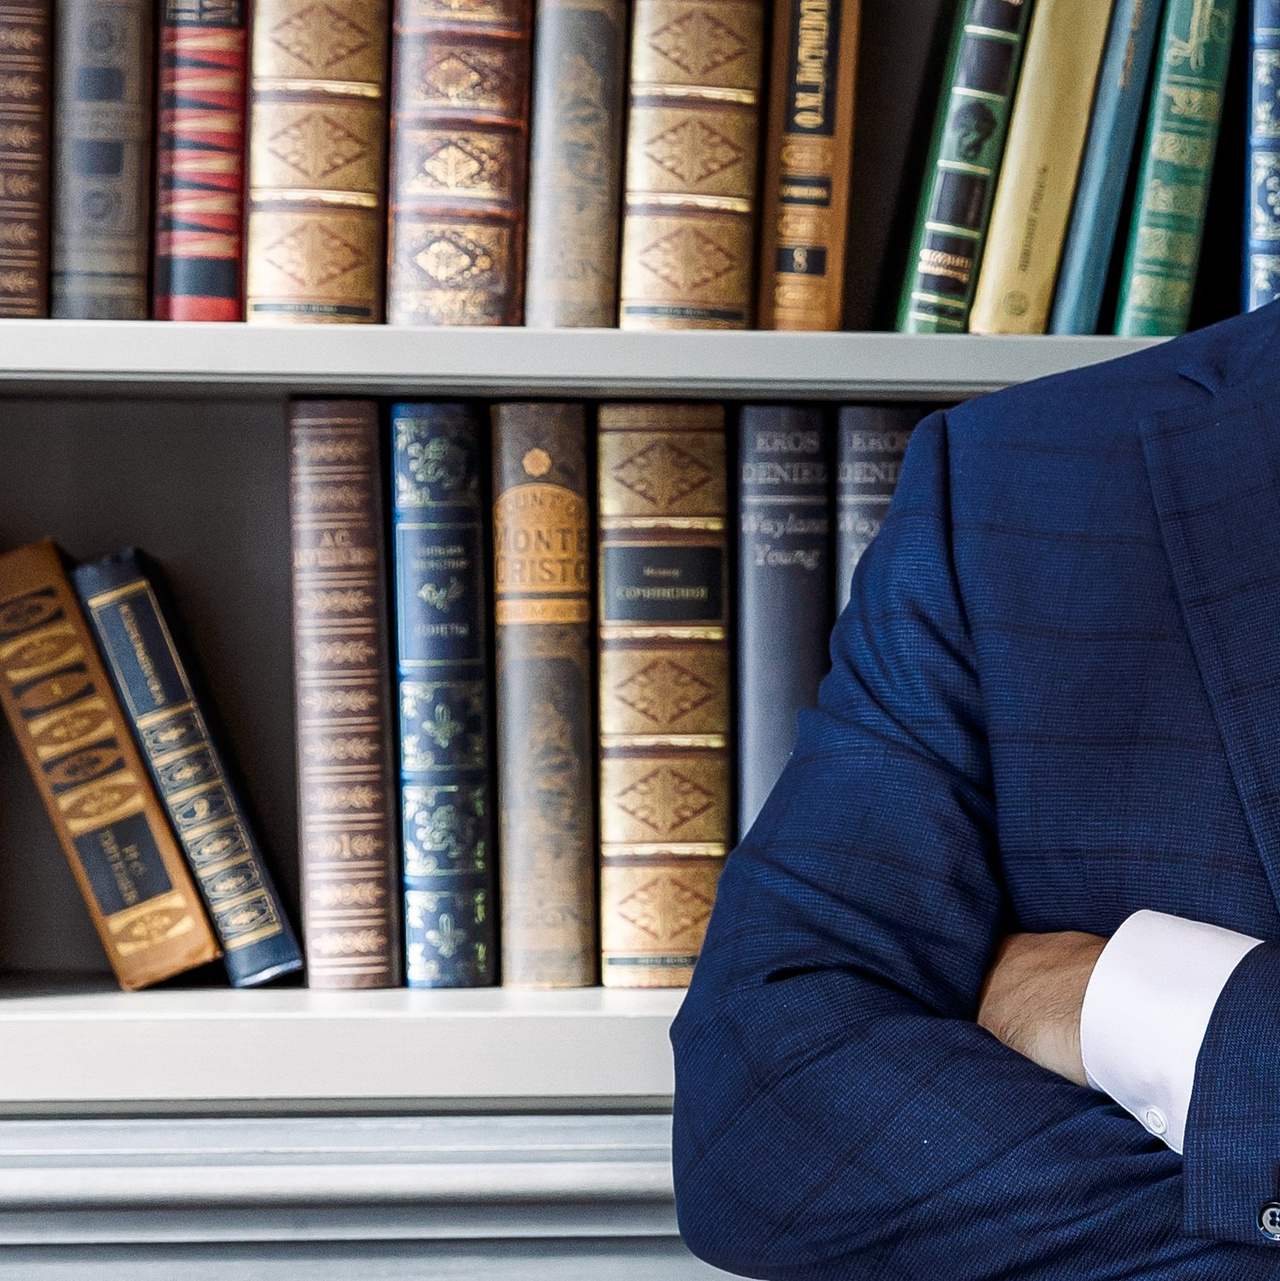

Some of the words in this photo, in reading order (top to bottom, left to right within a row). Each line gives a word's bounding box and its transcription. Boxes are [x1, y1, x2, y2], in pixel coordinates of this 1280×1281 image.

[755, 431, 820, 452] EROS
[851, 431, 905, 453] ERO
[837, 462, 899, 484] DENI
[755, 543, 820, 570] Young
[615, 586, 708, 599] СОЧИНЕНИЯ
